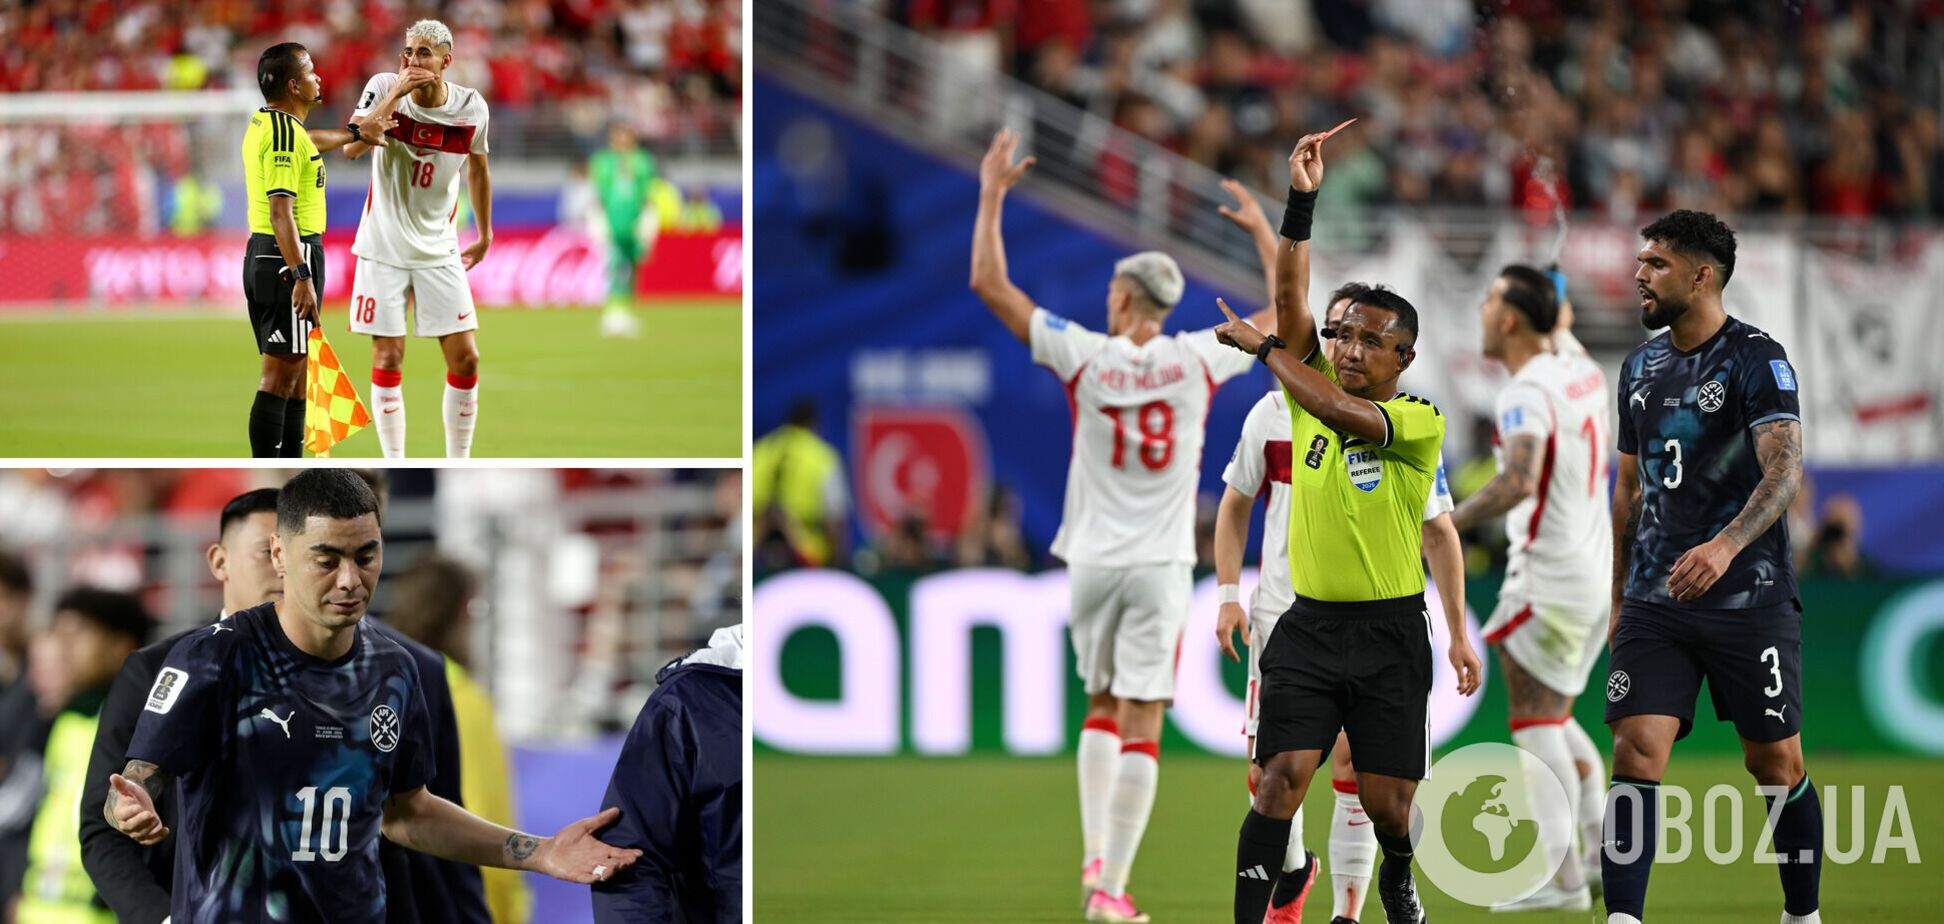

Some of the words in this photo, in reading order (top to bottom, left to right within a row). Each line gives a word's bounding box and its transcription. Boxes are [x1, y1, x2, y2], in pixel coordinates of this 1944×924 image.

[411, 160, 434, 188] 18
[356, 295, 376, 324] 18
[1097, 399, 1176, 472] 18
[1348, 449, 1378, 465] FIFA
[1663, 439, 1683, 489] 3
[1351, 466, 1381, 477] REFEREE
[1362, 482, 1375, 490] 2026
[1760, 645, 1783, 699] 3
[379, 708, 389, 717] APF
[291, 786, 352, 862] 10
